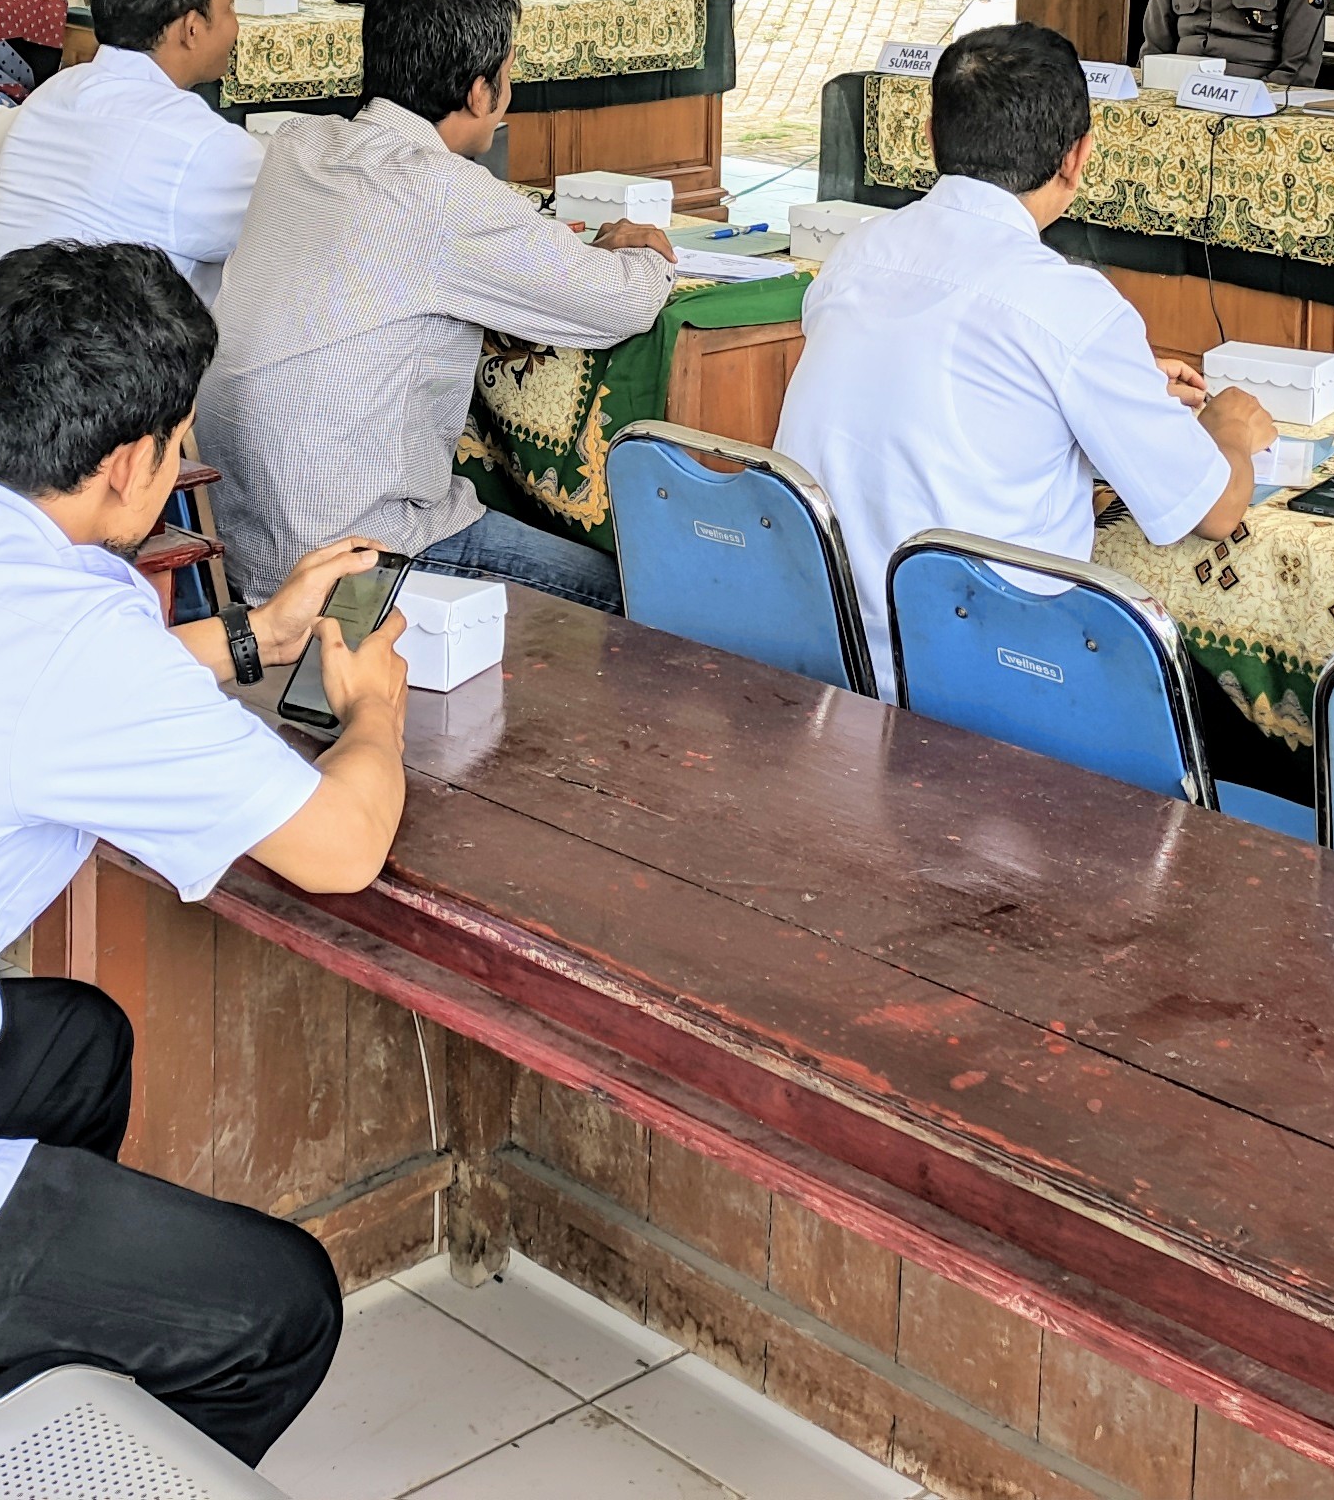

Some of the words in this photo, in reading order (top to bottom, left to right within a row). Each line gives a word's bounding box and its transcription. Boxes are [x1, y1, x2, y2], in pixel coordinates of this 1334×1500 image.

[899, 47, 930, 60] NARA
[888, 57, 933, 71] SUMBER
[1190, 82, 1239, 103] CAMAT
[698, 525, 741, 544] wellness
[1002, 652, 1057, 678] wellness
